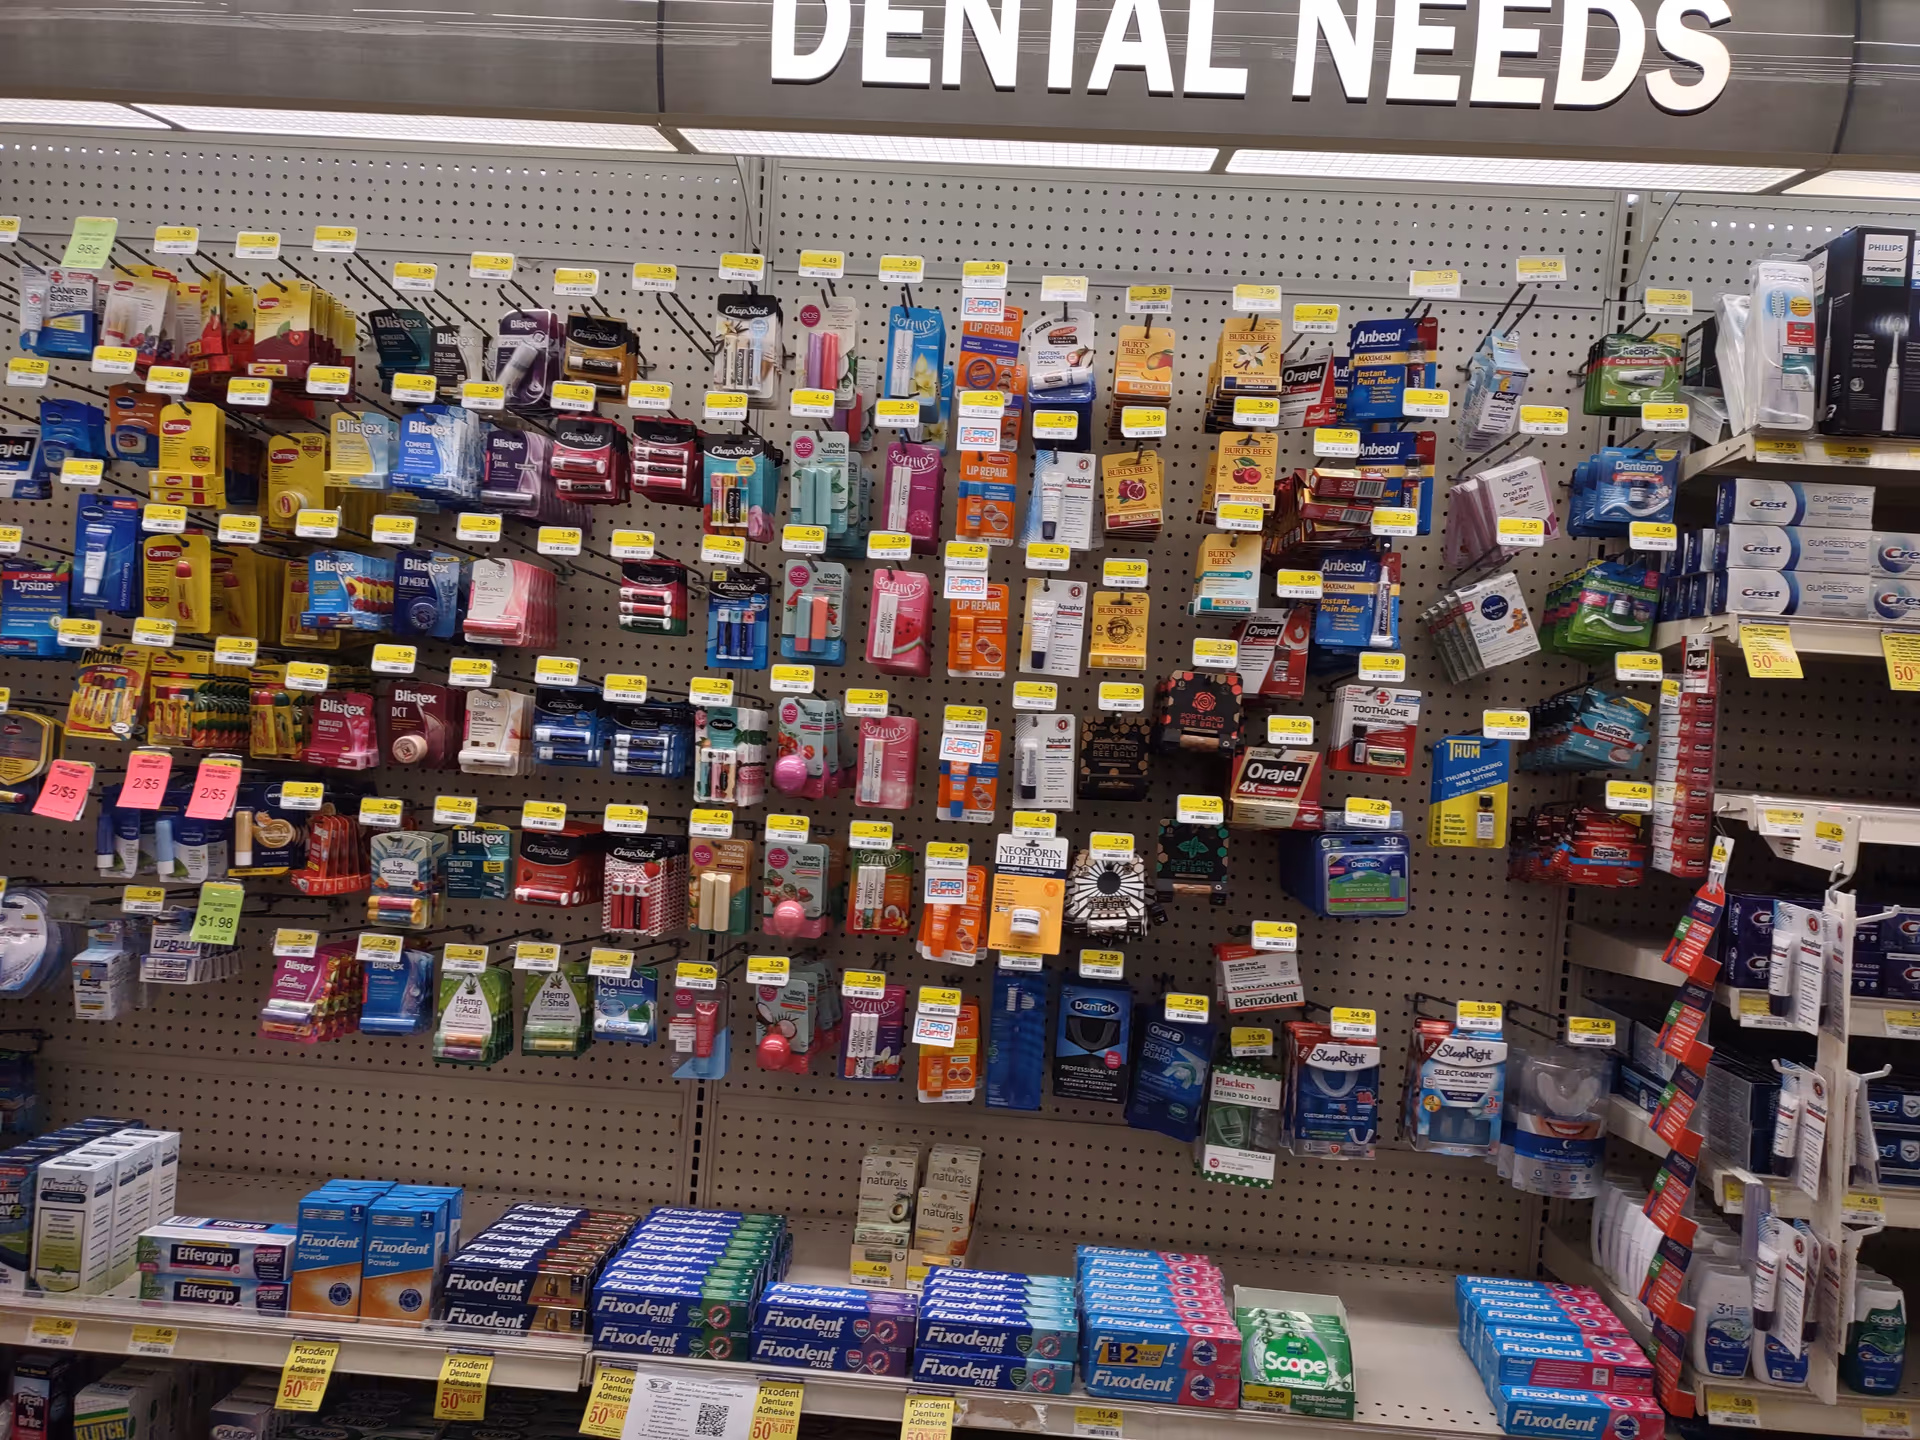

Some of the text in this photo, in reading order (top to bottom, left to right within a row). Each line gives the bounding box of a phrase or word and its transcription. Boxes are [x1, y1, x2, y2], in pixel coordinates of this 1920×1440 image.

[1292, 0, 1731, 113] NEEDS
[1867, 243, 1904, 253] PHILIPS
[657, 266, 672, 274] 3.99
[1866, 264, 1902, 273] sonicare
[49, 286, 88, 297] CANKER
[725, 304, 768, 317] ChapStick
[801, 310, 818, 320] eos
[893, 313, 937, 331] softlips
[969, 322, 1014, 337] LIP REPAIR
[437, 332, 475, 347] Blistex
[1356, 329, 1403, 345] Anbesol
[1284, 367, 1323, 383] Orajel
[1357, 369, 1388, 378] Instant
[1357, 377, 1402, 386] Pain Relief
[815, 393, 830, 401] 4.49
[337, 420, 383, 436] Blistex
[409, 420, 451, 436] Blistex
[561, 431, 604, 444] ChapStick
[1337, 431, 1354, 439] 7.99
[711, 445, 755, 457] ChapStick
[795, 441, 812, 450] eos
[1359, 442, 1400, 456] Anbesol
[966, 465, 1008, 478] LIP REPAIR
[1615, 460, 1664, 474] Dentemp
[1749, 499, 1788, 510] Crest
[1813, 494, 1869, 505] GUMRESTORE
[1243, 508, 1259, 516] 4.75
[1395, 513, 1412, 521] 7.29
[1521, 522, 1538, 530] 7.99
[805, 529, 820, 537] 4.99
[892, 536, 907, 544] 2.99
[1808, 539, 1866, 550] GUMRESTORE
[146, 547, 183, 559] Carmex
[1742, 543, 1782, 554] Crest
[404, 557, 449, 575] Blistex
[1127, 564, 1142, 572] 3.99
[1322, 558, 1367, 574] Anbesol
[790, 570, 808, 579] eos
[1300, 574, 1316, 582] 8.99
[13, 579, 55, 593] Lysine
[718, 582, 757, 593] ChapStick
[876, 577, 921, 593] softlips
[1807, 584, 1865, 594] GUMRESTORE
[1741, 588, 1781, 599] Crest
[1057, 602, 1084, 612] Aquaphor
[1248, 625, 1280, 637] Orajel
[1384, 658, 1400, 666] 5.99
[795, 669, 810, 677] 3.29
[869, 691, 884, 699] 2.99
[1124, 687, 1140, 695] 3.29
[395, 689, 437, 705] Blistex
[391, 706, 408, 718] DCT
[1352, 704, 1410, 717] TOOTHACHE
[1180, 712, 1225, 721] PORTLAND
[1509, 715, 1526, 723] 6.99
[1181, 719, 1224, 729] BEE BALM
[1291, 721, 1307, 729] 9.49
[1446, 740, 1481, 762] THUM
[1246, 763, 1302, 788] Orajel
[1445, 761, 1503, 783] THUMB SUCKING
[132, 777, 159, 791] 2/$5
[1239, 780, 1257, 793] 4X
[49, 783, 77, 800] 2/$5
[200, 787, 227, 801] 2/$5
[1631, 786, 1648, 794] 4.49
[713, 812, 729, 820] 4.49
[1034, 816, 1050, 824] 4.99
[789, 818, 805, 826] 3.29
[873, 825, 887, 833] 3.99
[458, 830, 505, 846] Blistex
[527, 843, 570, 857] ChapStick
[613, 845, 656, 860] ChapStick
[723, 844, 745, 852] 100%
[949, 846, 964, 854] 4.29
[1000, 845, 1062, 859] NEOSPORIN
[693, 850, 711, 859] eos
[392, 860, 404, 869] Lip
[999, 854, 1062, 869] LIP HEALTH
[1351, 860, 1381, 869] DenTek
[381, 867, 417, 877] Succulence
[199, 915, 233, 930] $1.98
[1277, 925, 1293, 934] 4.49
[1099, 953, 1119, 961] 21.99
[598, 975, 644, 989] Natural
[866, 974, 882, 982] 3.99
[543, 991, 570, 1003] Hemp
[598, 986, 618, 998] Ice
[941, 992, 956, 1000] 4.29
[456, 996, 483, 1008] Hemp
[1184, 998, 1204, 1006] 21.99
[1234, 989, 1299, 1008] Benzodent
[1074, 1001, 1117, 1015] DenTek
[1476, 1004, 1497, 1012] 19.99
[1350, 1010, 1370, 1019] 24.99
[1591, 1021, 1611, 1029] 34.99
[1151, 1025, 1182, 1043] Oral-B
[1144, 1041, 1175, 1058] DENTAL
[1437, 1044, 1494, 1063] SleepRight
[1143, 1049, 1173, 1065] GUARD
[1311, 1048, 1367, 1065] SleepRight
[1215, 1077, 1256, 1091] Plackers
[1213, 1090, 1238, 1099] GRIND
[1251, 1095, 1272, 1103] MORE
[866, 1175, 908, 1188] naturals
[932, 1171, 973, 1185] naturals
[41, 1180, 89, 1193] Kleenite
[214, 1220, 266, 1231] Effergrip
[176, 1247, 233, 1266] Effergrip
[368, 1258, 401, 1268] Powder
[445, 1273, 526, 1294] Fixodent
[179, 1284, 234, 1303] Effergrip
[496, 1294, 523, 1302] ULTRA
[597, 1297, 680, 1320] Fixodent
[446, 1307, 526, 1329] Fixodent
[652, 1315, 673, 1324] PLUS
[763, 1309, 846, 1331] Fixodent
[599, 1326, 680, 1351] Fixodent
[818, 1329, 840, 1338] PLUS
[1495, 1328, 1575, 1343] Fixodent
[652, 1346, 674, 1355] PLUS
[756, 1340, 839, 1363] Fixodent
[981, 1345, 1004, 1354] PLUS
[1123, 1345, 1138, 1364] 2
[1138, 1349, 1162, 1358] VALUE
[810, 1360, 832, 1369] PLUS
[1264, 1350, 1328, 1378] Scope
[449, 1368, 482, 1379] Denture
[444, 1378, 483, 1389] Adhesive
[974, 1379, 997, 1388] PLUS
[1092, 1369, 1179, 1393] Fixodent
[1268, 1390, 1285, 1399] 5.99
[1511, 1388, 1589, 1403] Fixodent
[761, 1397, 794, 1407] Denture
[757, 1406, 796, 1417] Adhesive
[912, 1410, 945, 1419] Denture
[1097, 1410, 1119, 1420] 11.49
[909, 1418, 947, 1427] Adhesive
[1511, 1409, 1600, 1433] Fixodent
